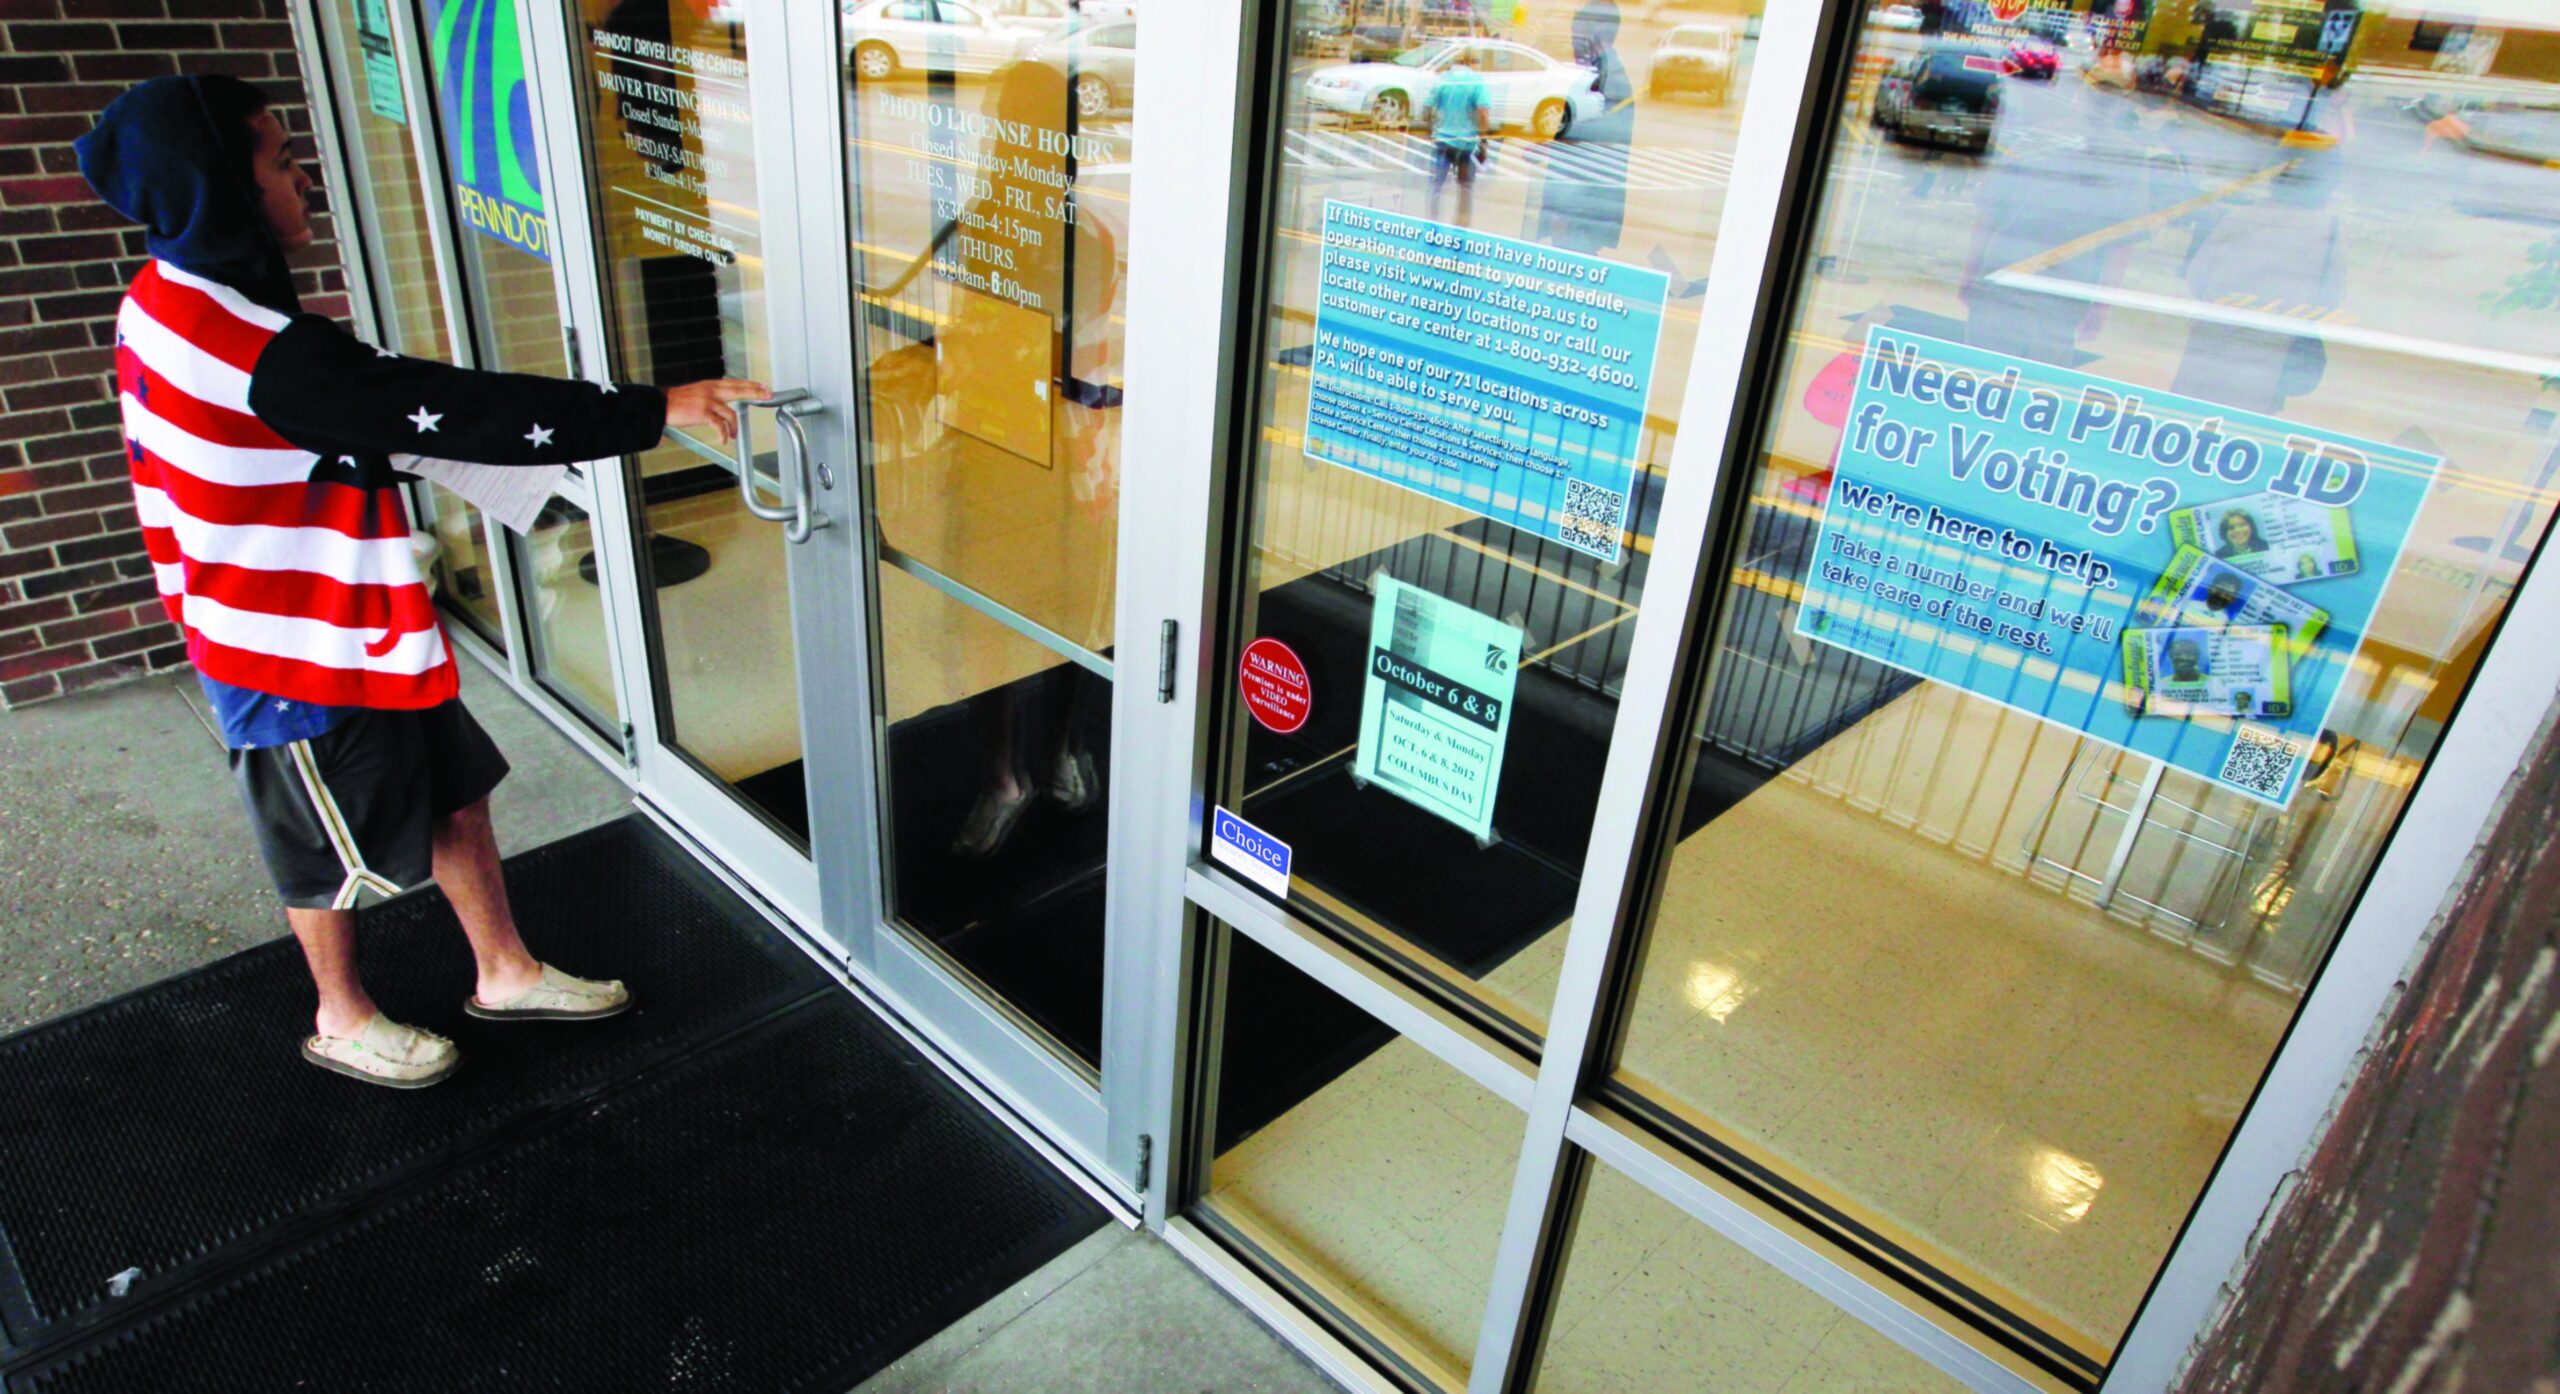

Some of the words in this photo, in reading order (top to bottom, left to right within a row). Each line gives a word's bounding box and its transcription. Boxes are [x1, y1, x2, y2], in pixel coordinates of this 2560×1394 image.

[593, 29, 632, 53] PENNDOT
[634, 37, 667, 62] DRIVER
[667, 44, 706, 70] LICENSE
[706, 53, 746, 78] CENTER
[598, 70, 644, 98] DRIVER
[644, 81, 700, 113] TESTING
[621, 101, 651, 125] Closed
[624, 132, 729, 179] TUESDAY-SATURDAY
[879, 93, 942, 127] PHOTO
[946, 107, 1032, 149] LICENSE
[1037, 127, 1114, 164] HOURS
[644, 161, 712, 199] 8:30am-4:15pm
[906, 160, 952, 193] TUES.,
[955, 173, 1000, 208] WED.,
[1005, 187, 1041, 219] FRI.,
[910, 132, 954, 160] Closed
[956, 142, 1074, 196] Sunday-Monday
[458, 184, 549, 256] PENNDOT
[634, 206, 674, 230] PAYMENT
[674, 220, 686, 233] BY
[687, 225, 718, 246] CHECK
[720, 238, 734, 251] OR
[642, 226, 672, 247] MONEY
[673, 238, 704, 260] ORDER
[704, 249, 728, 268] ONLY
[936, 197, 1042, 247] 8:30am-4:15pm
[1328, 205, 1341, 222] If
[1343, 209, 1370, 229] this
[1374, 216, 1421, 240] center
[1424, 226, 1462, 250] does
[1465, 236, 1490, 256] not
[1494, 242, 1533, 266] have
[1536, 252, 1585, 278] hours
[1587, 263, 1608, 284] of
[960, 235, 1018, 272] THURS.
[1326, 226, 1395, 259] operation
[1398, 244, 1482, 278] convenient
[1485, 264, 1502, 282] to
[1504, 271, 1543, 296] your
[1545, 278, 1630, 317] schedule,
[937, 257, 1042, 309] 8:30am-6:00pm
[1325, 247, 1370, 275] please
[1373, 259, 1405, 281] visit
[1408, 268, 1577, 328] www.dmv.state.pa.us
[1579, 311, 1598, 330] to
[1322, 290, 1386, 320] customer
[1388, 309, 1420, 329] care
[1423, 317, 1472, 344] center
[1475, 331, 1491, 349] at
[1494, 335, 1641, 392] 1-800-932-4600.
[1323, 268, 1366, 293] locate
[1368, 280, 1407, 304] other
[1410, 291, 1463, 322] nearby
[1465, 305, 1540, 338] locations
[1543, 329, 1561, 345] or
[1565, 330, 1598, 354] call
[1600, 344, 1631, 363] our
[1317, 349, 1335, 367] PA
[1339, 355, 1364, 376] will
[1367, 364, 1384, 382] be
[1387, 370, 1417, 392] able
[1420, 380, 1436, 398] to
[1439, 389, 1480, 412] serve
[1482, 402, 1517, 426] you.
[1319, 329, 1339, 348] We
[1342, 335, 1375, 361] hope
[1379, 349, 1404, 368] one
[1407, 355, 1423, 373] of
[1425, 363, 1450, 381] our
[1453, 371, 1472, 391] 71
[1475, 374, 1549, 411] locations
[1552, 400, 1608, 428] across
[1310, 412, 1335, 428] License
[1388, 438, 1408, 452] enter
[1408, 447, 1426, 460] your
[1426, 451, 1438, 464] zip
[1311, 400, 1334, 416] Locate
[1340, 410, 1366, 426] Service
[1395, 427, 1411, 441] then
[1412, 433, 1437, 449] choose
[1446, 445, 1473, 461] Locate
[1473, 454, 1498, 470] Driver
[1312, 390, 1336, 404] choose
[1337, 397, 1359, 414] option
[1371, 407, 1398, 424] Service
[1399, 416, 1424, 432] Center
[1424, 425, 1460, 444] Locations
[1461, 437, 1468, 447] &
[1468, 439, 1505, 460] Services,
[1505, 452, 1523, 465] then
[1524, 458, 1554, 475] choose
[1374, 396, 1388, 408] Call
[1452, 421, 1472, 435] After
[1472, 428, 1509, 448] selecting
[1509, 441, 1529, 455] your
[1867, 336, 2021, 423] Need
[2020, 387, 2062, 435] a
[2067, 385, 2263, 484] Photo
[2266, 434, 2370, 508] ID
[1853, 401, 1937, 468] for
[1949, 422, 2181, 537] Voting?
[1840, 479, 1922, 528] We're
[1925, 506, 1996, 550] here
[1999, 528, 2034, 562] to
[2035, 539, 2118, 590] help.
[1821, 559, 1869, 591] take
[1872, 580, 1922, 609] care
[1926, 598, 1954, 621] of
[1955, 603, 1994, 633] the
[1997, 620, 2053, 655] rest.
[1828, 531, 1882, 566] Take
[1885, 554, 1900, 572] a
[1903, 560, 1997, 602] number
[1997, 590, 2047, 622] and
[2049, 606, 2113, 642] we'll
[1831, 620, 1897, 649] pennsylvania
[1242, 668, 1276, 691] Premises
[1277, 683, 1285, 695] is
[1285, 687, 1308, 706] under
[1249, 651, 1305, 686] WARNING
[1376, 654, 1445, 698] October
[1447, 685, 1459, 706] 6
[1462, 692, 1480, 715] &
[1484, 702, 1497, 723] 8
[1250, 692, 1296, 721] Surveillance
[1259, 686, 1288, 707] VIDEO
[2268, 703, 2281, 713] ID
[1389, 709, 1432, 738] Saturday
[1433, 730, 1442, 742] &
[1446, 736, 1487, 763] Monday
[1393, 734, 1420, 756] OCT.
[1421, 746, 1427, 758] 6
[1428, 751, 1438, 763] &
[1451, 763, 1475, 782] 2012
[1387, 753, 1450, 793] COLUMBUS
[1450, 784, 1474, 805] DAY
[1221, 818, 1283, 868] Choice
